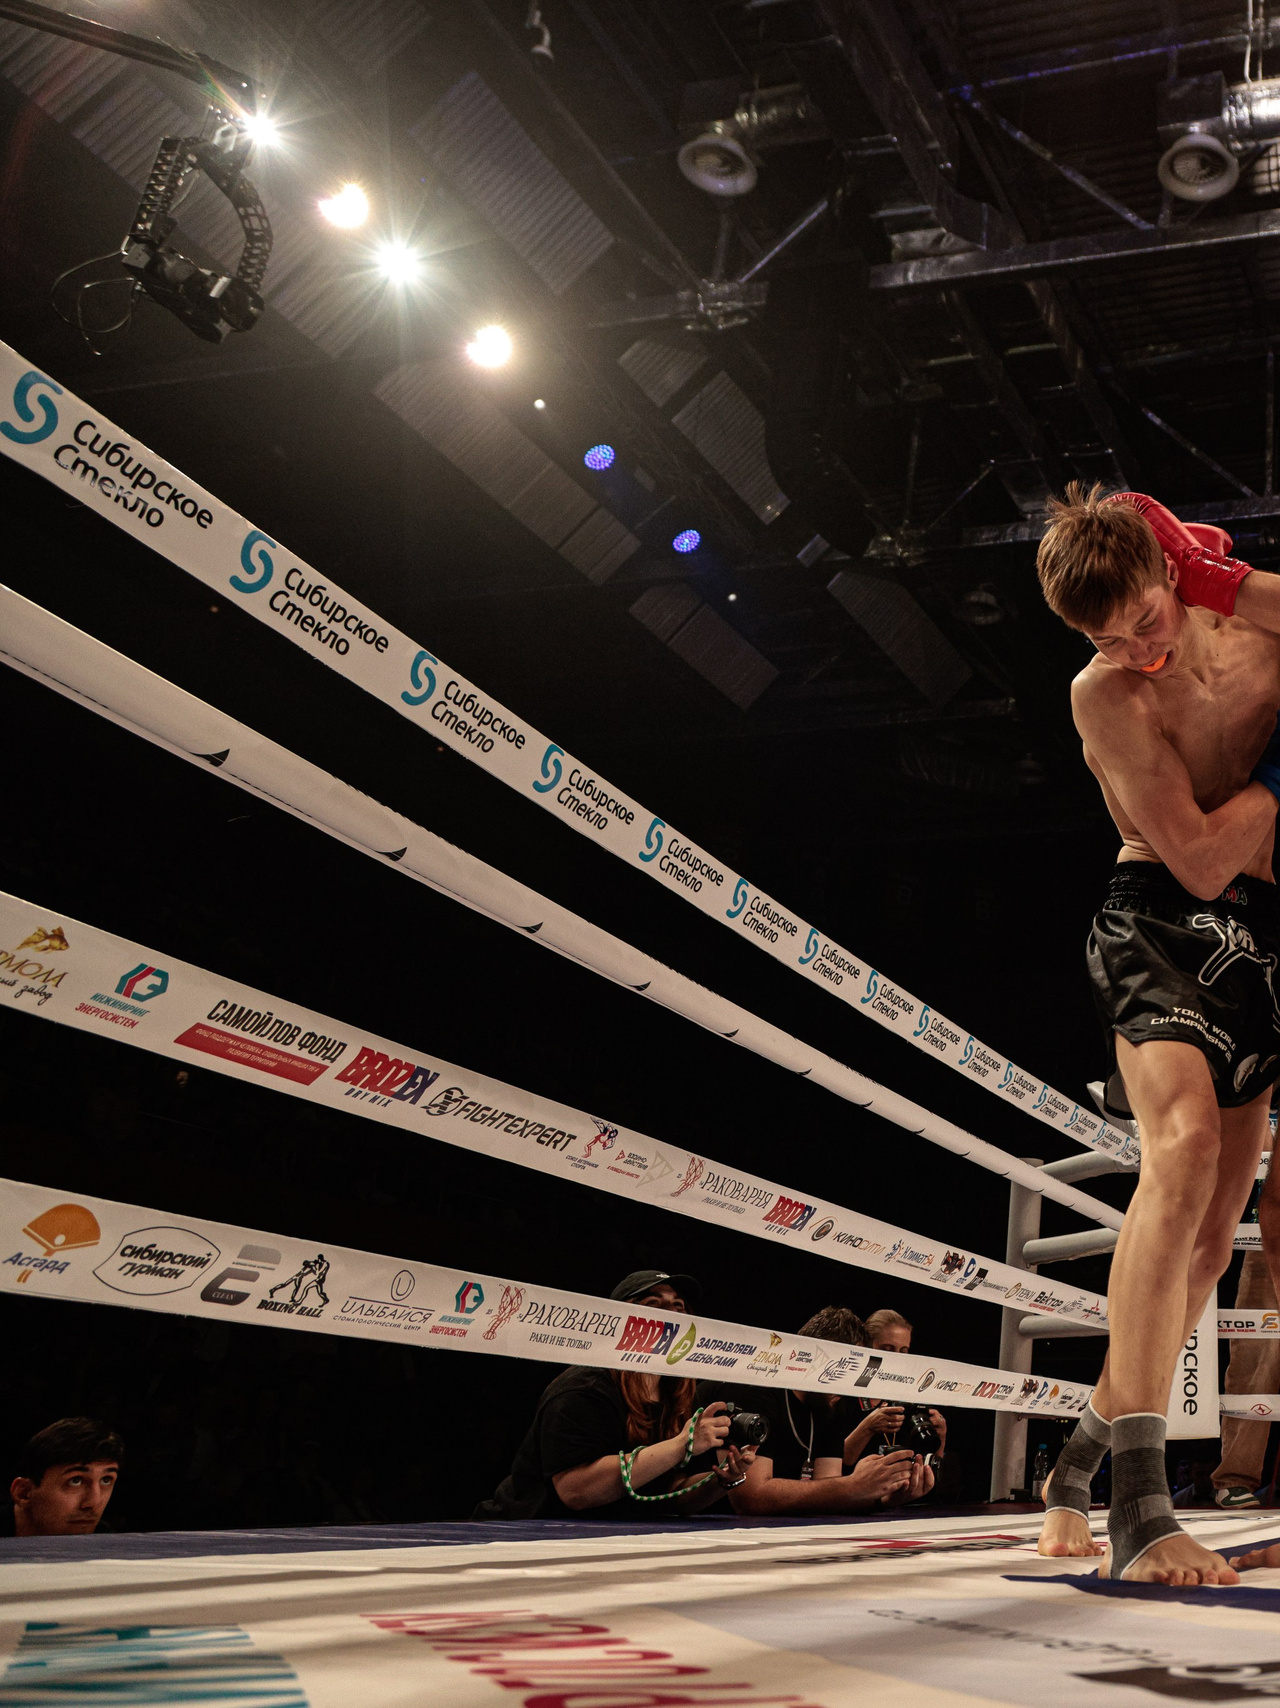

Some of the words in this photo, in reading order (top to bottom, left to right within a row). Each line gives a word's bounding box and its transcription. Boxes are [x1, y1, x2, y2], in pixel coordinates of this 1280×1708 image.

[53, 443, 165, 528] Стекло
[73, 419, 214, 529] Сибирское
[268, 590, 350, 656] Стекло
[283, 568, 389, 653] Сибирское
[431, 701, 494, 752] Стекло
[444, 680, 526, 749] Сибирское
[557, 787, 608, 830] Стекло
[568, 769, 635, 824] Сибирское
[659, 855, 702, 893] Стекло
[667, 839, 723, 886] Сибирское
[743, 912, 778, 943] Стекло
[750, 896, 798, 936] Сибирское
[813, 959, 843, 985] Стекло
[821, 944, 860, 979] Сибирское
[89, 992, 151, 1018] ИНЖИНИРИНГ
[872, 997, 898, 1021] Стекло
[880, 984, 914, 1014] Сибирское
[74, 1002, 139, 1029] ЭНЕРГОСИСТЕМ
[1172, 1007, 1209, 1028] YOUTH
[206, 999, 301, 1047] САМОЙЛОВ
[297, 1031, 348, 1064] ФОНД
[923, 1030, 947, 1051] Стекло
[931, 1018, 960, 1045] Сибирское
[968, 1059, 989, 1077] Стекло
[975, 1047, 1001, 1071] Сибирское
[334, 1046, 440, 1106] BROZEX
[344, 1088, 372, 1102] DRY
[370, 1093, 393, 1108] MIX
[453, 1100, 578, 1152] FIGHTEXPERT
[701, 1171, 773, 1209] РАКОВАРНЯ
[762, 1195, 817, 1232] BROZEX
[119, 1243, 212, 1270] сибирский
[835, 1231, 885, 1255] КИНОСИТИ
[903, 1246, 935, 1267] Климат54
[2, 1251, 72, 1274] Асгард
[117, 1259, 184, 1280] гурман
[212, 1292, 235, 1300] CLEAN
[256, 1299, 299, 1314] BOXING
[296, 1306, 324, 1318] HALL
[333, 1315, 402, 1328] СТОМАТОЛОГИЧЕСКИЙ
[429, 1325, 468, 1338] ЭНЕРГОСИСТЕМ
[520, 1301, 621, 1338] РАКОВАРНЯ
[529, 1332, 550, 1345] РАКИ
[549, 1335, 556, 1345] И
[556, 1335, 567, 1347] НЕ
[564, 1336, 592, 1351] ТОЛЬКО
[615, 1315, 680, 1356] BROZEX
[696, 1336, 758, 1356] ЗАПРАВЛЯЕМ
[685, 1352, 738, 1368] ДЕНЬГАМИ
